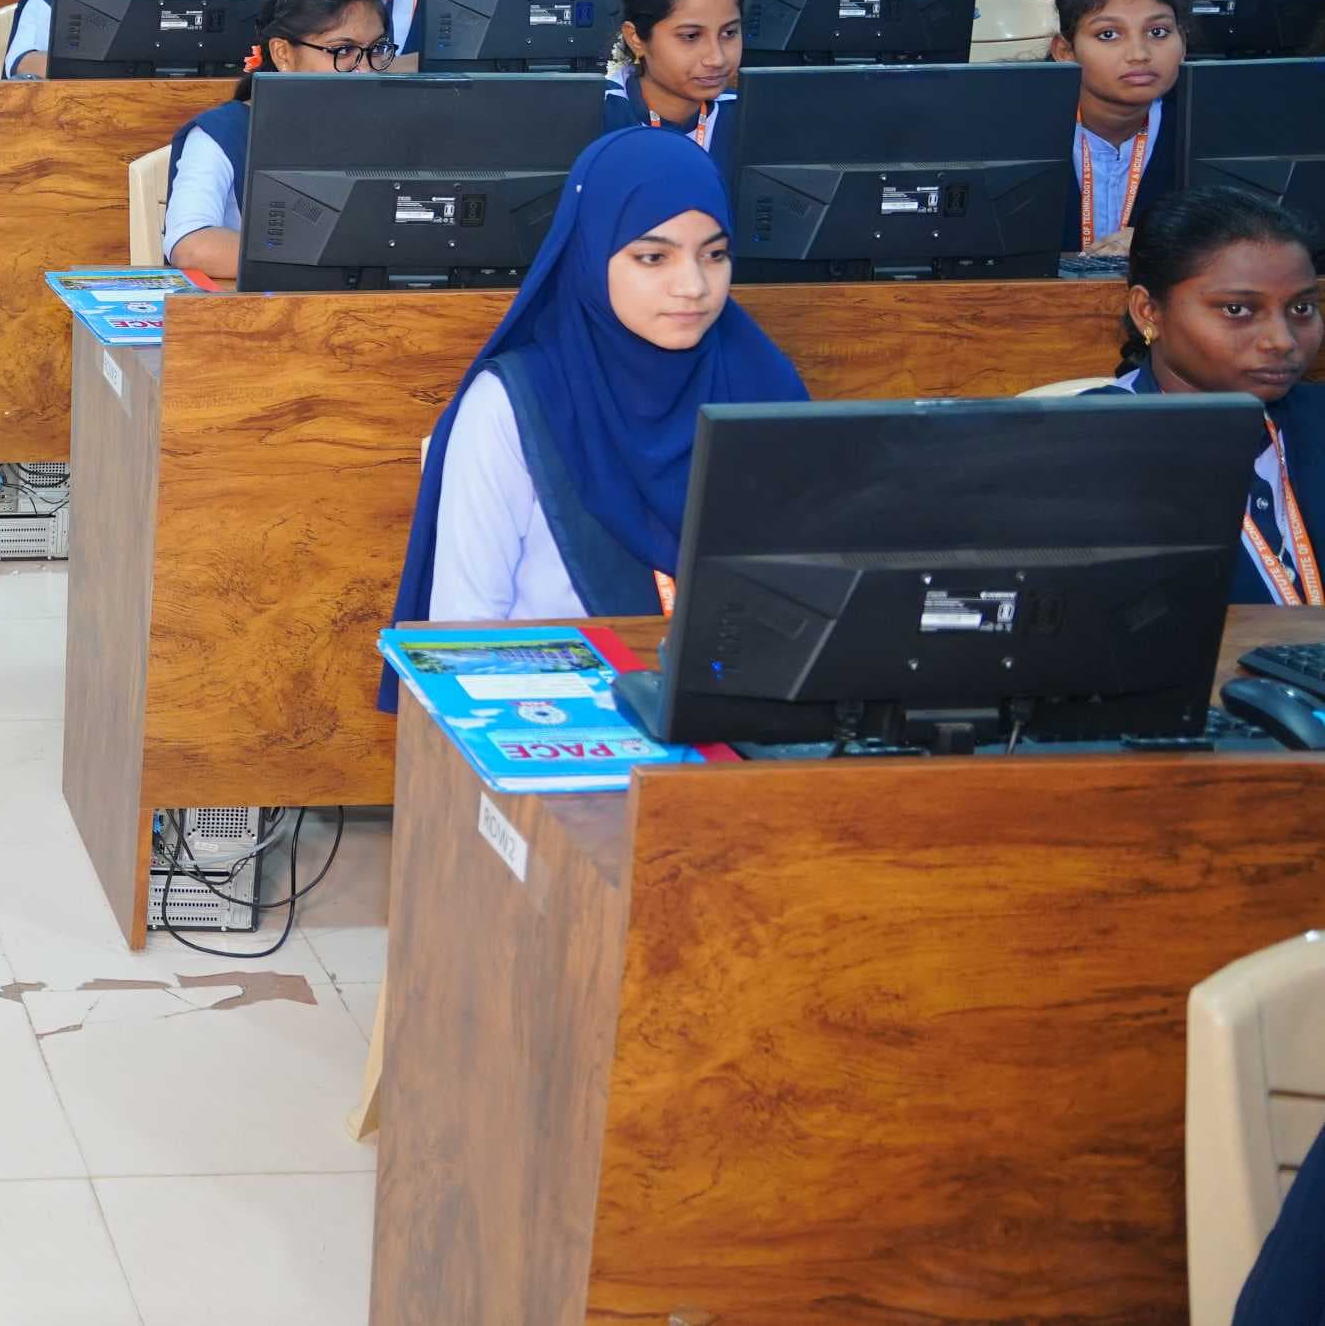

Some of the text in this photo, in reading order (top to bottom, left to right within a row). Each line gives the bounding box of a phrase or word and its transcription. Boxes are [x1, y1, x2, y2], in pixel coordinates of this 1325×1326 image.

[112, 320, 164, 329] ACE
[500, 743, 615, 759] PACE
[483, 805, 516, 862] ROW2
